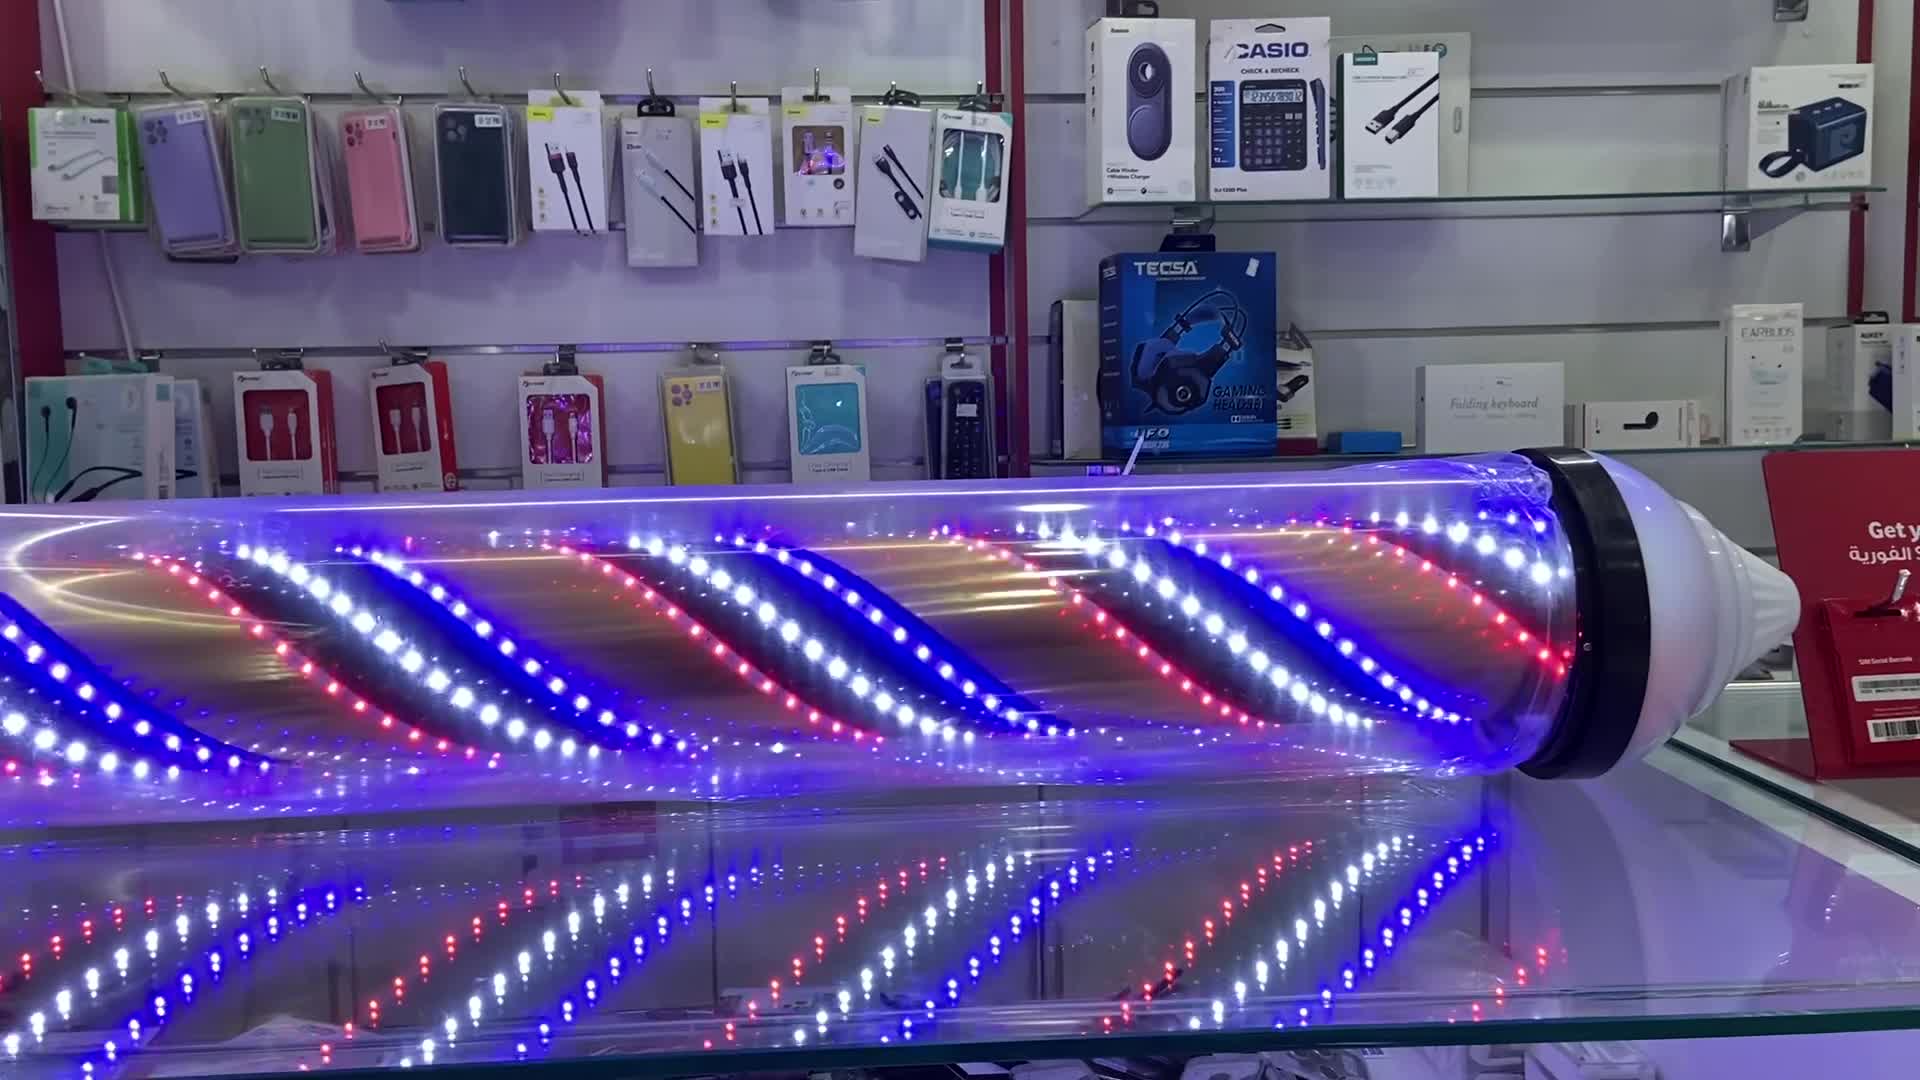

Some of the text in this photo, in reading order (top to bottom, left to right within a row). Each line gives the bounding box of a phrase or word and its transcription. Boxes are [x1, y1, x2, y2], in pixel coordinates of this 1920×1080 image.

[1236, 42, 1309, 59] CASIO
[1133, 261, 1198, 276] TECSA
[1741, 327, 1794, 337] EARBUDS
[1450, 395, 1539, 411] Folding keyboard
[1868, 521, 1907, 539] Get
[1849, 545, 1912, 564] الفورية
